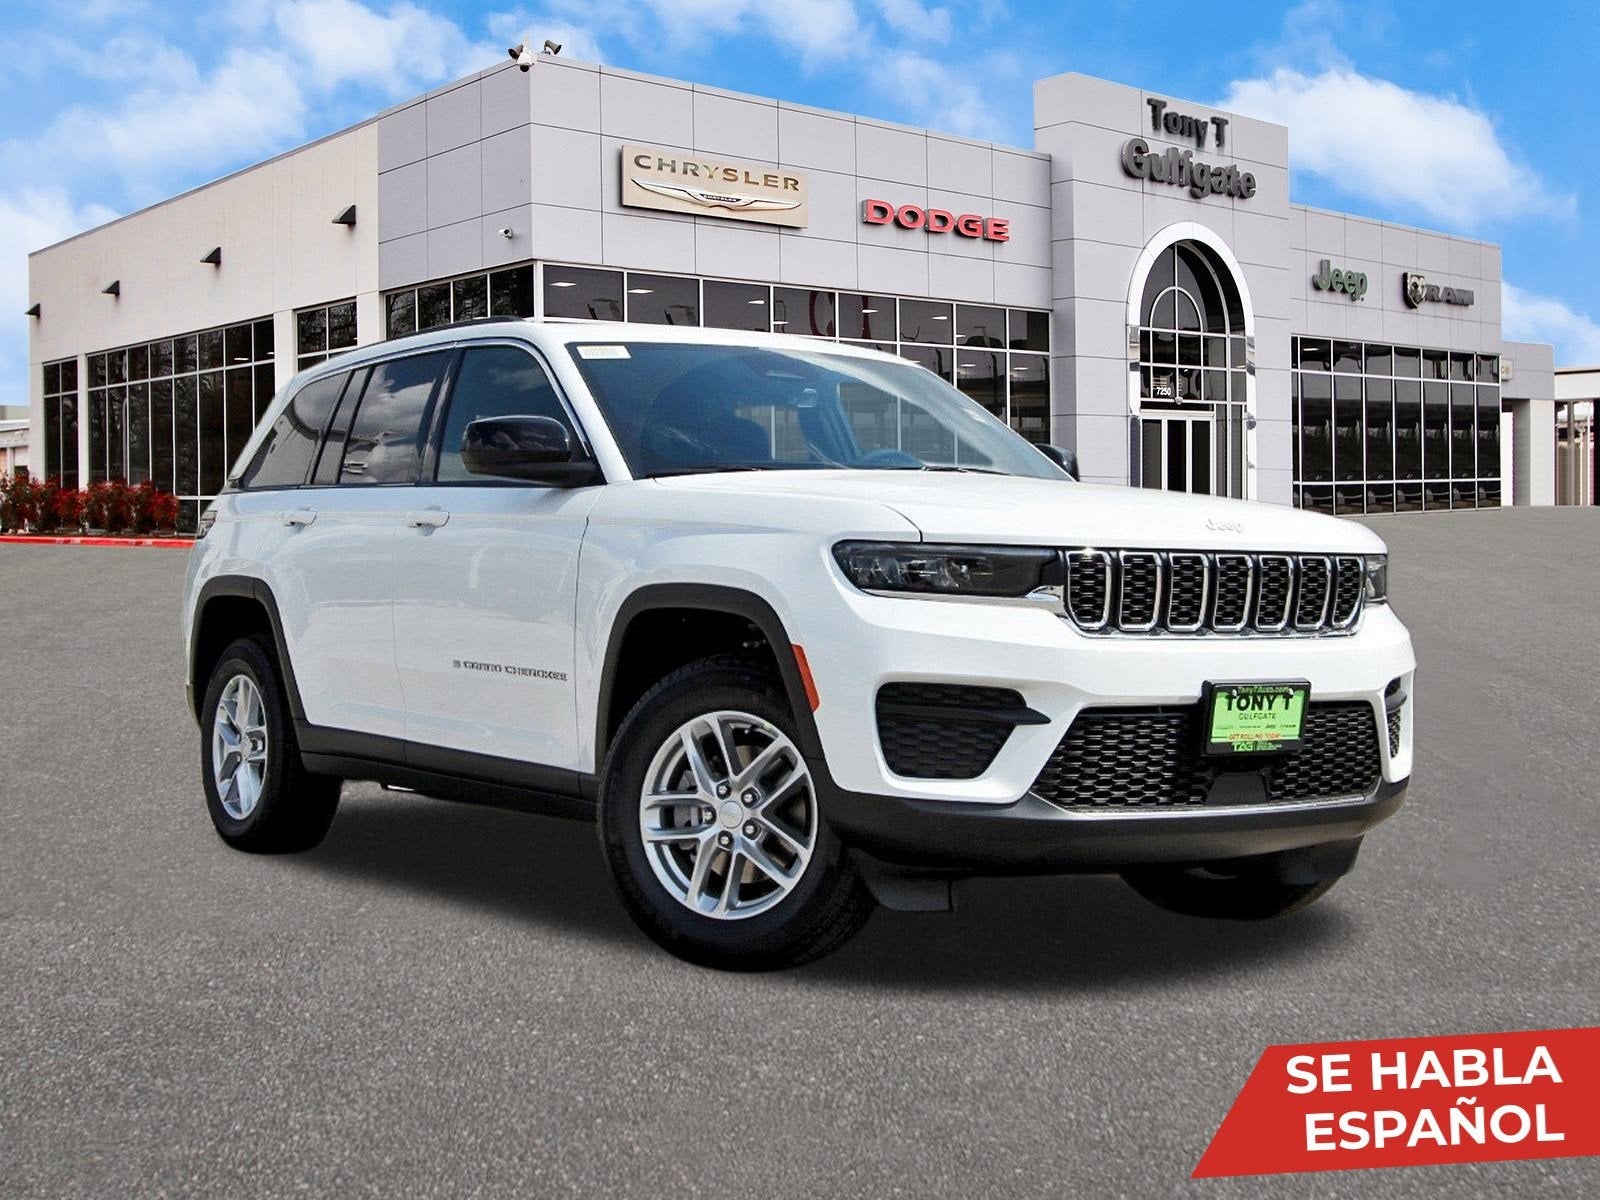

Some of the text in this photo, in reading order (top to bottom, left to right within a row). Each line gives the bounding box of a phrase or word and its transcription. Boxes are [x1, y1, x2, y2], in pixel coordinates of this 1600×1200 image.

[1147, 98, 1229, 147] Tony T
[633, 154, 801, 192] CHRYSLER
[1121, 138, 1257, 199] Gulfgate
[862, 198, 1010, 243] DODGE
[1312, 259, 1369, 302] Jeep
[1425, 284, 1475, 306] RAM
[1225, 694, 1294, 711] TONY T
